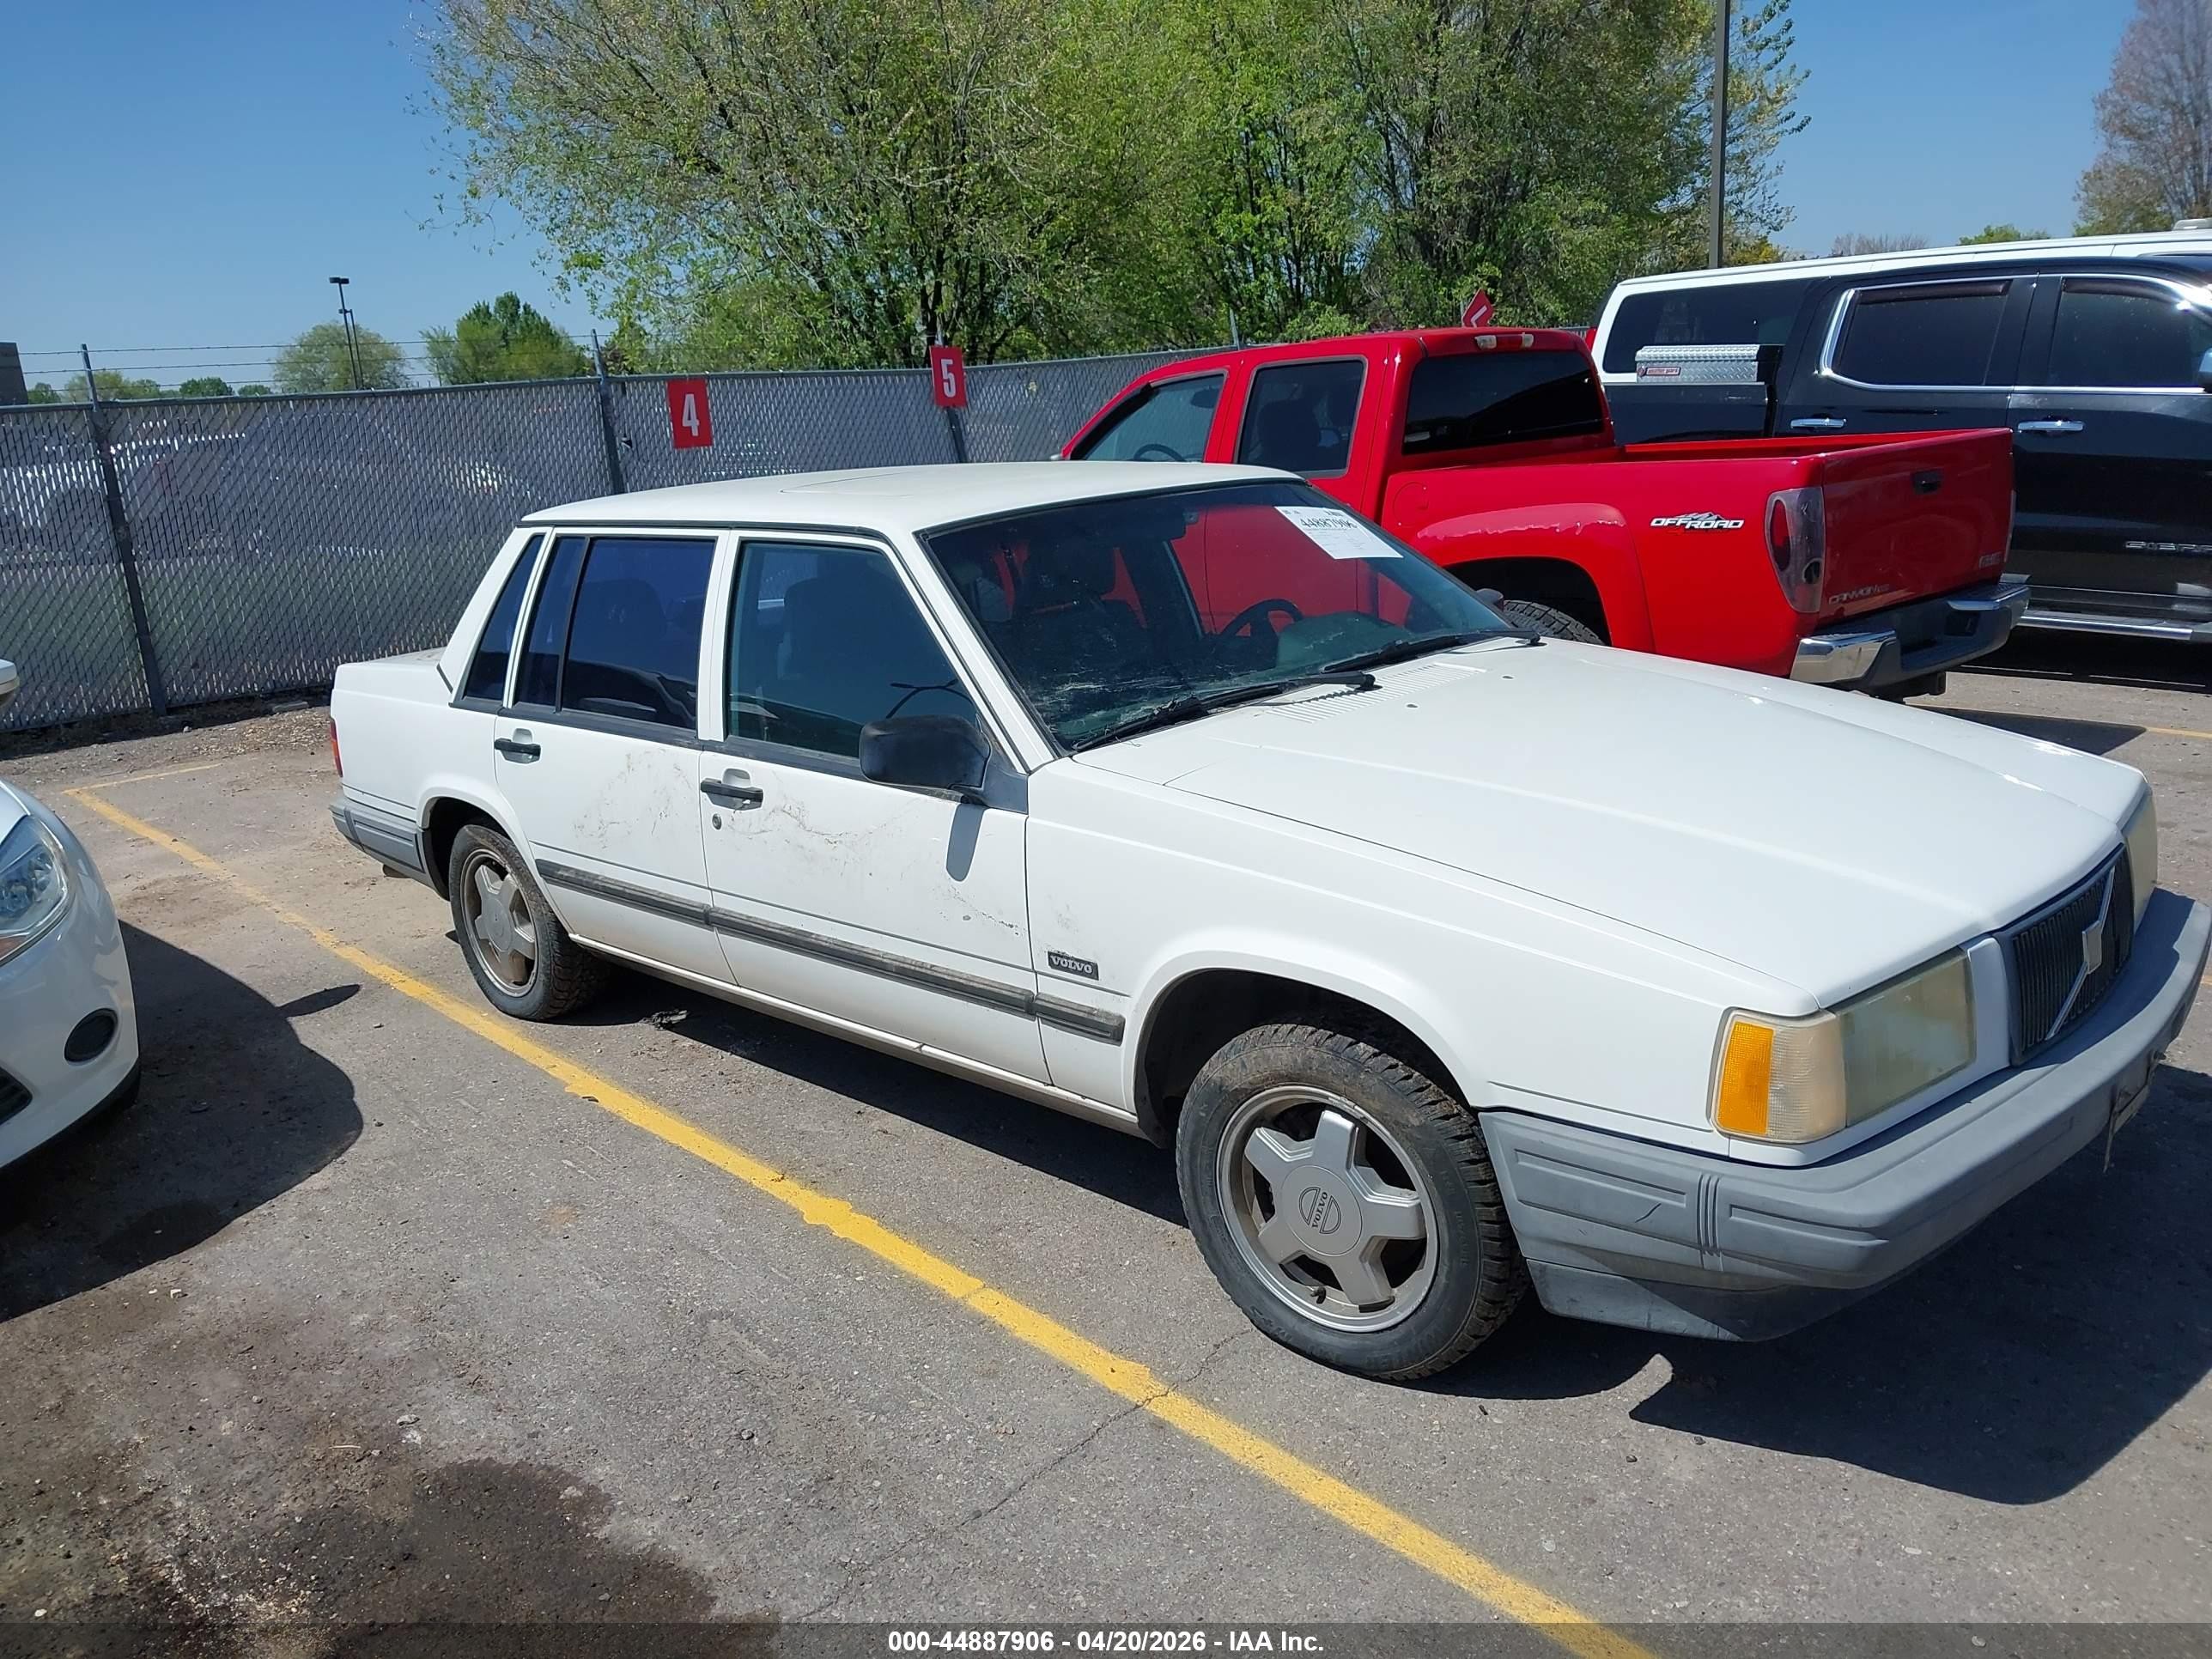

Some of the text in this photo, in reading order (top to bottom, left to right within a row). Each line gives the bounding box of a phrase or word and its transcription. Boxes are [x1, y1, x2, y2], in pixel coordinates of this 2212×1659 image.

[940, 358, 957, 398] 5
[682, 393, 700, 437] 4
[1049, 955, 1093, 974] VOLVO
[1310, 1191, 1328, 1229] VOLVO
